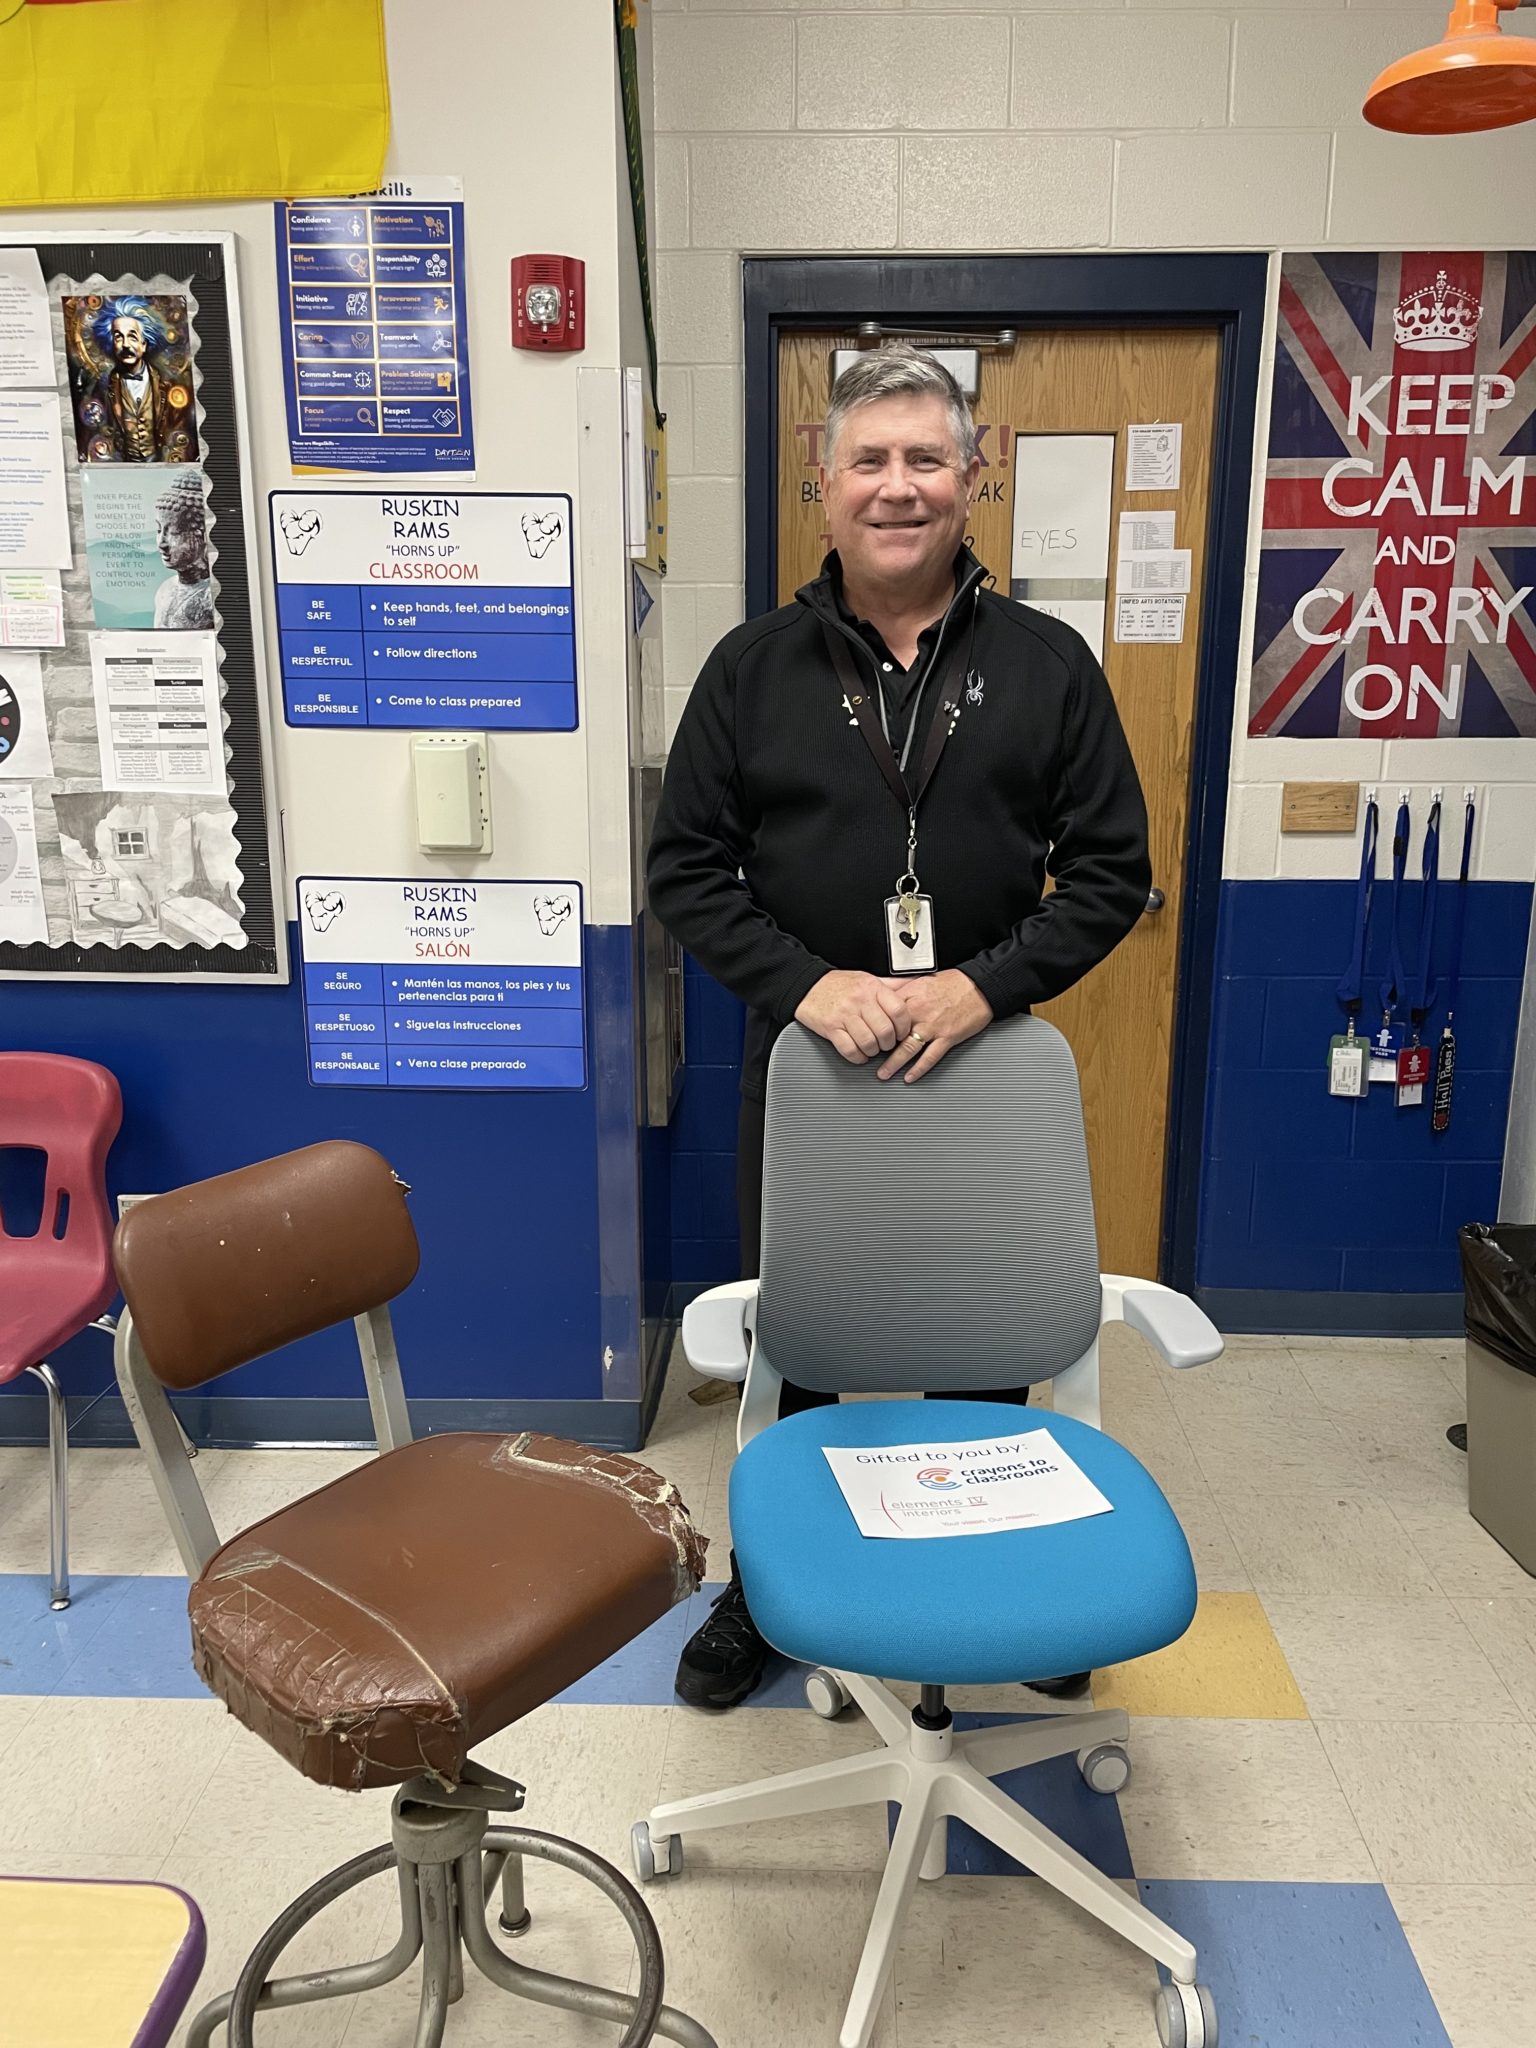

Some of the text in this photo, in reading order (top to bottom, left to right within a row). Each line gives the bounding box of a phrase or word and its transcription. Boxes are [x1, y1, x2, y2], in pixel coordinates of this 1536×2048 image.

[291, 215, 332, 224] Confidence
[373, 215, 414, 224] Motivation
[293, 254, 315, 263] Effort
[376, 254, 421, 264] Responsibility
[295, 294, 329, 303] Initiative
[568, 289, 576, 330] FIRE
[297, 332, 324, 343] Caring
[379, 332, 419, 341] Teamwork
[299, 370, 352, 378] Common Sense
[380, 370, 435, 379] Problem Solving
[303, 406, 325, 414] Focus
[1346, 374, 1516, 436] KEEP
[383, 406, 411, 416] Respect
[1321, 456, 1527, 517] CALM
[381, 498, 460, 517] RUSKIN
[393, 521, 450, 539] RAMS
[1021, 529, 1078, 556] EYES
[1372, 535, 1456, 566] AND
[369, 562, 479, 580] CLASSROOM
[106, 580, 146, 588] EMOTIONS
[311, 600, 325, 609] BE
[383, 601, 570, 617] Keep hands, feet, and belongings
[306, 611, 332, 620] SAFE
[383, 616, 417, 626] to self
[1292, 586, 1535, 646] CARRY
[313, 646, 327, 655] BE
[386, 647, 478, 659] Follow directions
[291, 657, 353, 666] RESPECTFUL
[318, 693, 332, 702] BE
[1344, 663, 1462, 721] ON
[388, 695, 521, 709] Come to class prepared
[294, 704, 359, 714] RESPONSIBLE
[403, 886, 477, 903] RUSKIN
[414, 905, 468, 922] RAMS
[415, 940, 470, 958] SALÓN
[335, 972, 348, 980] SE
[323, 982, 362, 990] SEGURO
[404, 978, 571, 992] Mantén las manos, los pies y tus
[398, 992, 504, 1003] pertenencias para ti
[338, 1013, 351, 1021] SE
[314, 1023, 376, 1032] RESPETUOSO
[453, 1020, 522, 1031] instrucciones
[340, 1052, 353, 1060] SE
[314, 1061, 380, 1070] RESPONSABLE
[439, 1059, 468, 1069] clase
[470, 1059, 527, 1070] preparado
[1437, 1050, 1453, 1109] Hall Pass
[856, 1443, 1028, 1464] Gifted to you by:
[961, 1459, 1047, 1477] crayons to
[966, 1465, 1059, 1485] classrooms
[891, 1496, 986, 1509] elements IV
[902, 1508, 962, 1518] interiors
